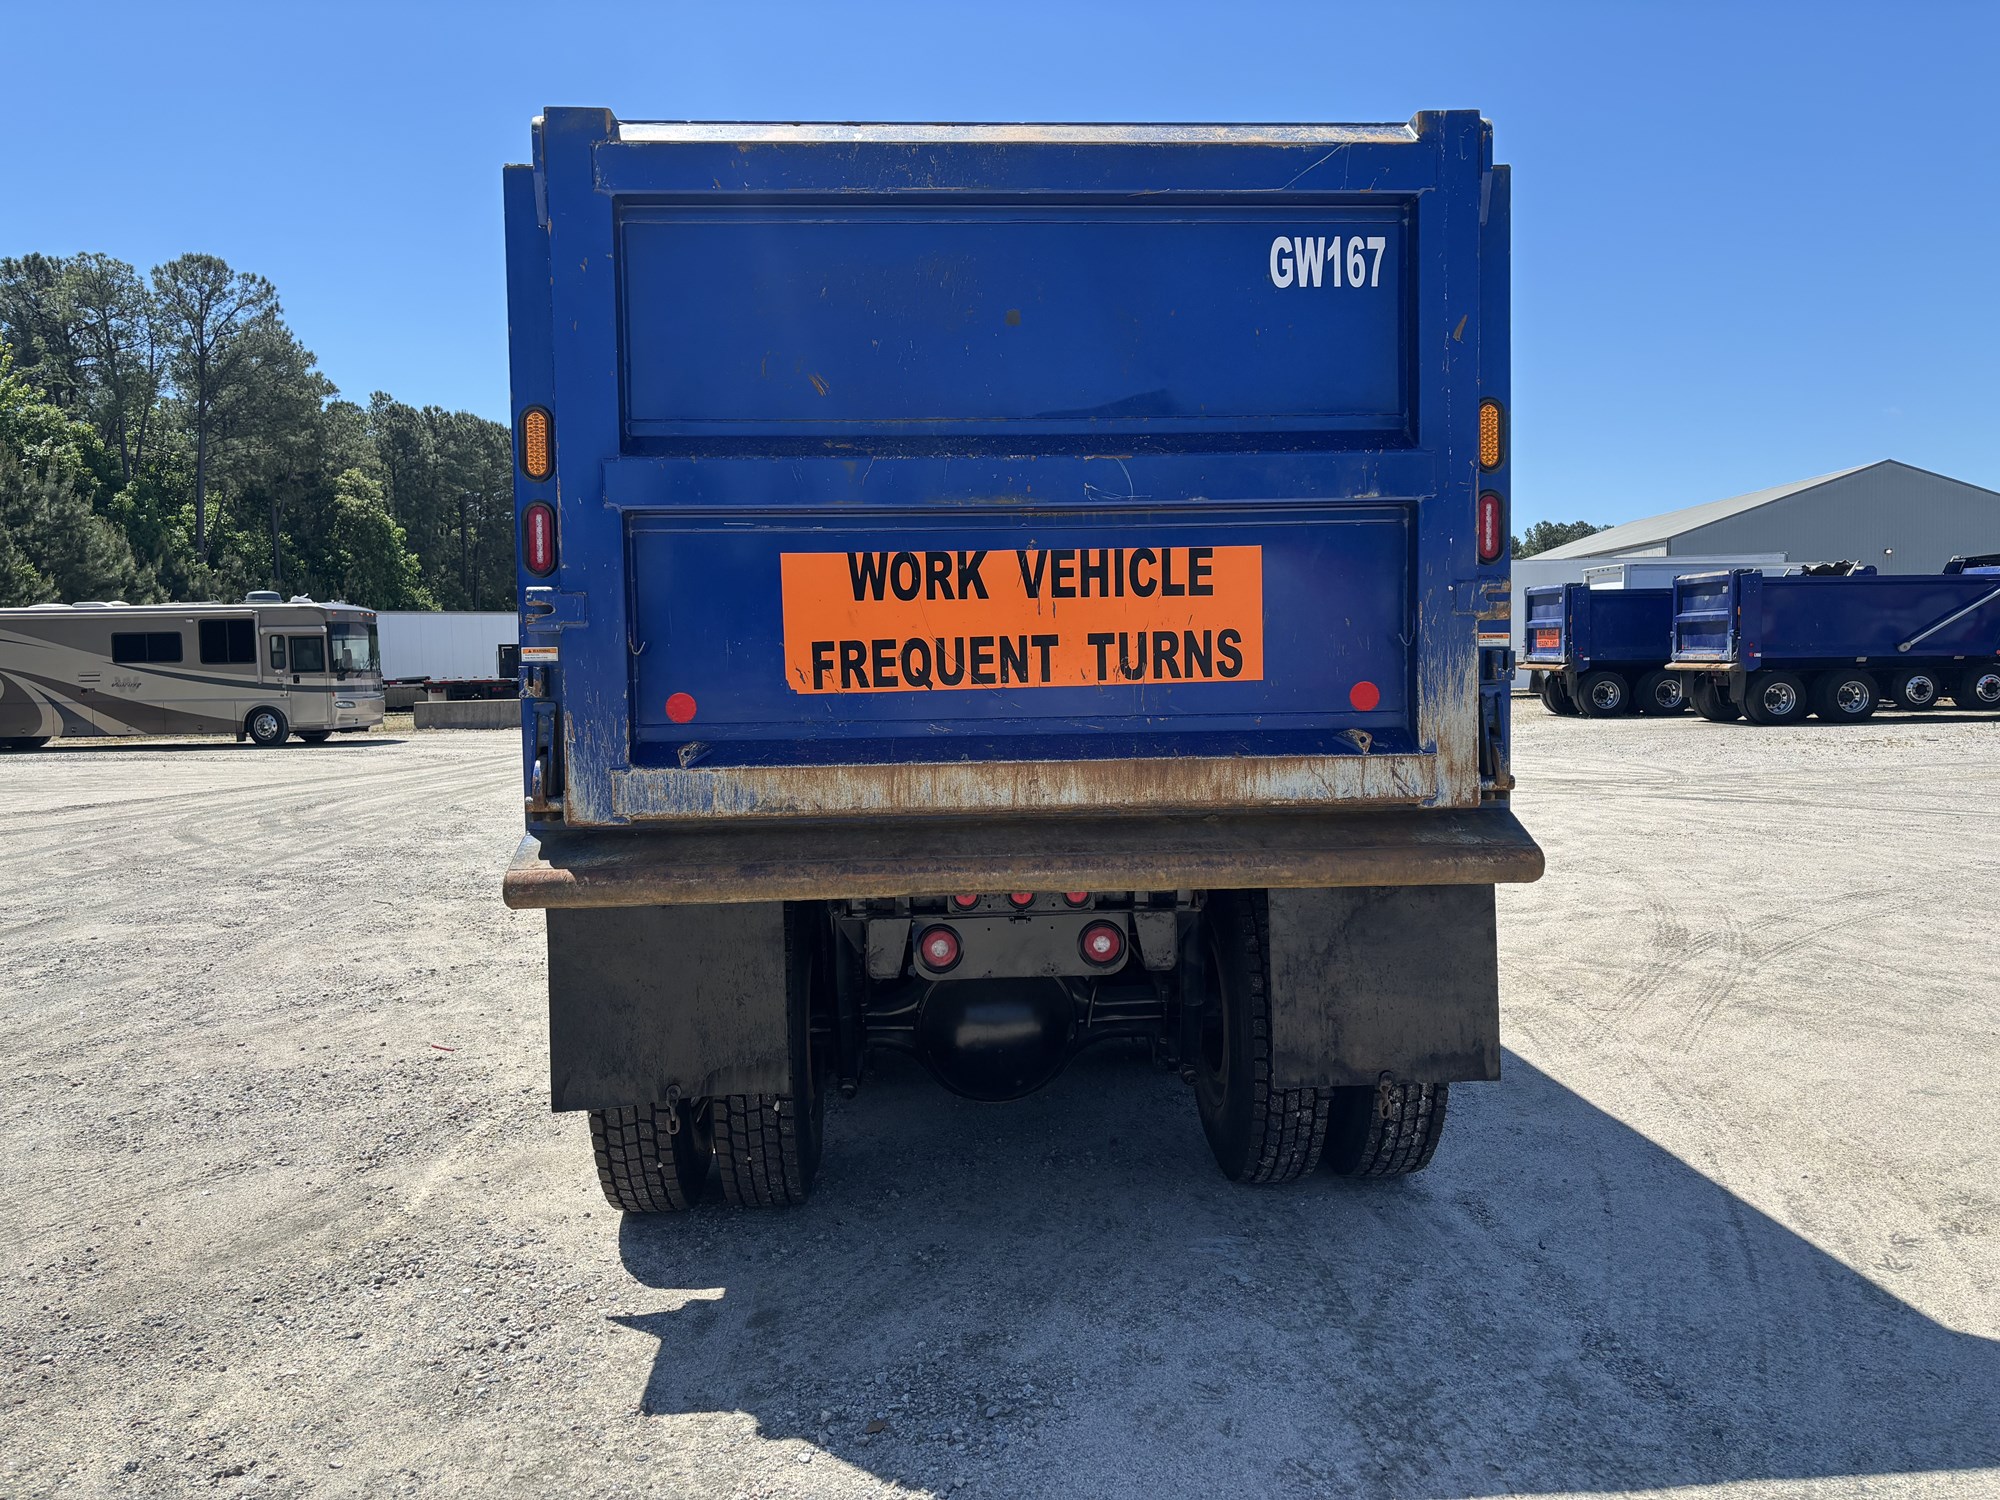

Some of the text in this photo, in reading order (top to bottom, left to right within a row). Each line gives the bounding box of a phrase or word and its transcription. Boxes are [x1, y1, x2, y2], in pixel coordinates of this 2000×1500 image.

[1269, 235, 1387, 289] GW167
[847, 547, 1214, 601] WORK VEHICLE
[811, 628, 1244, 690] FREQUENT TURNS
